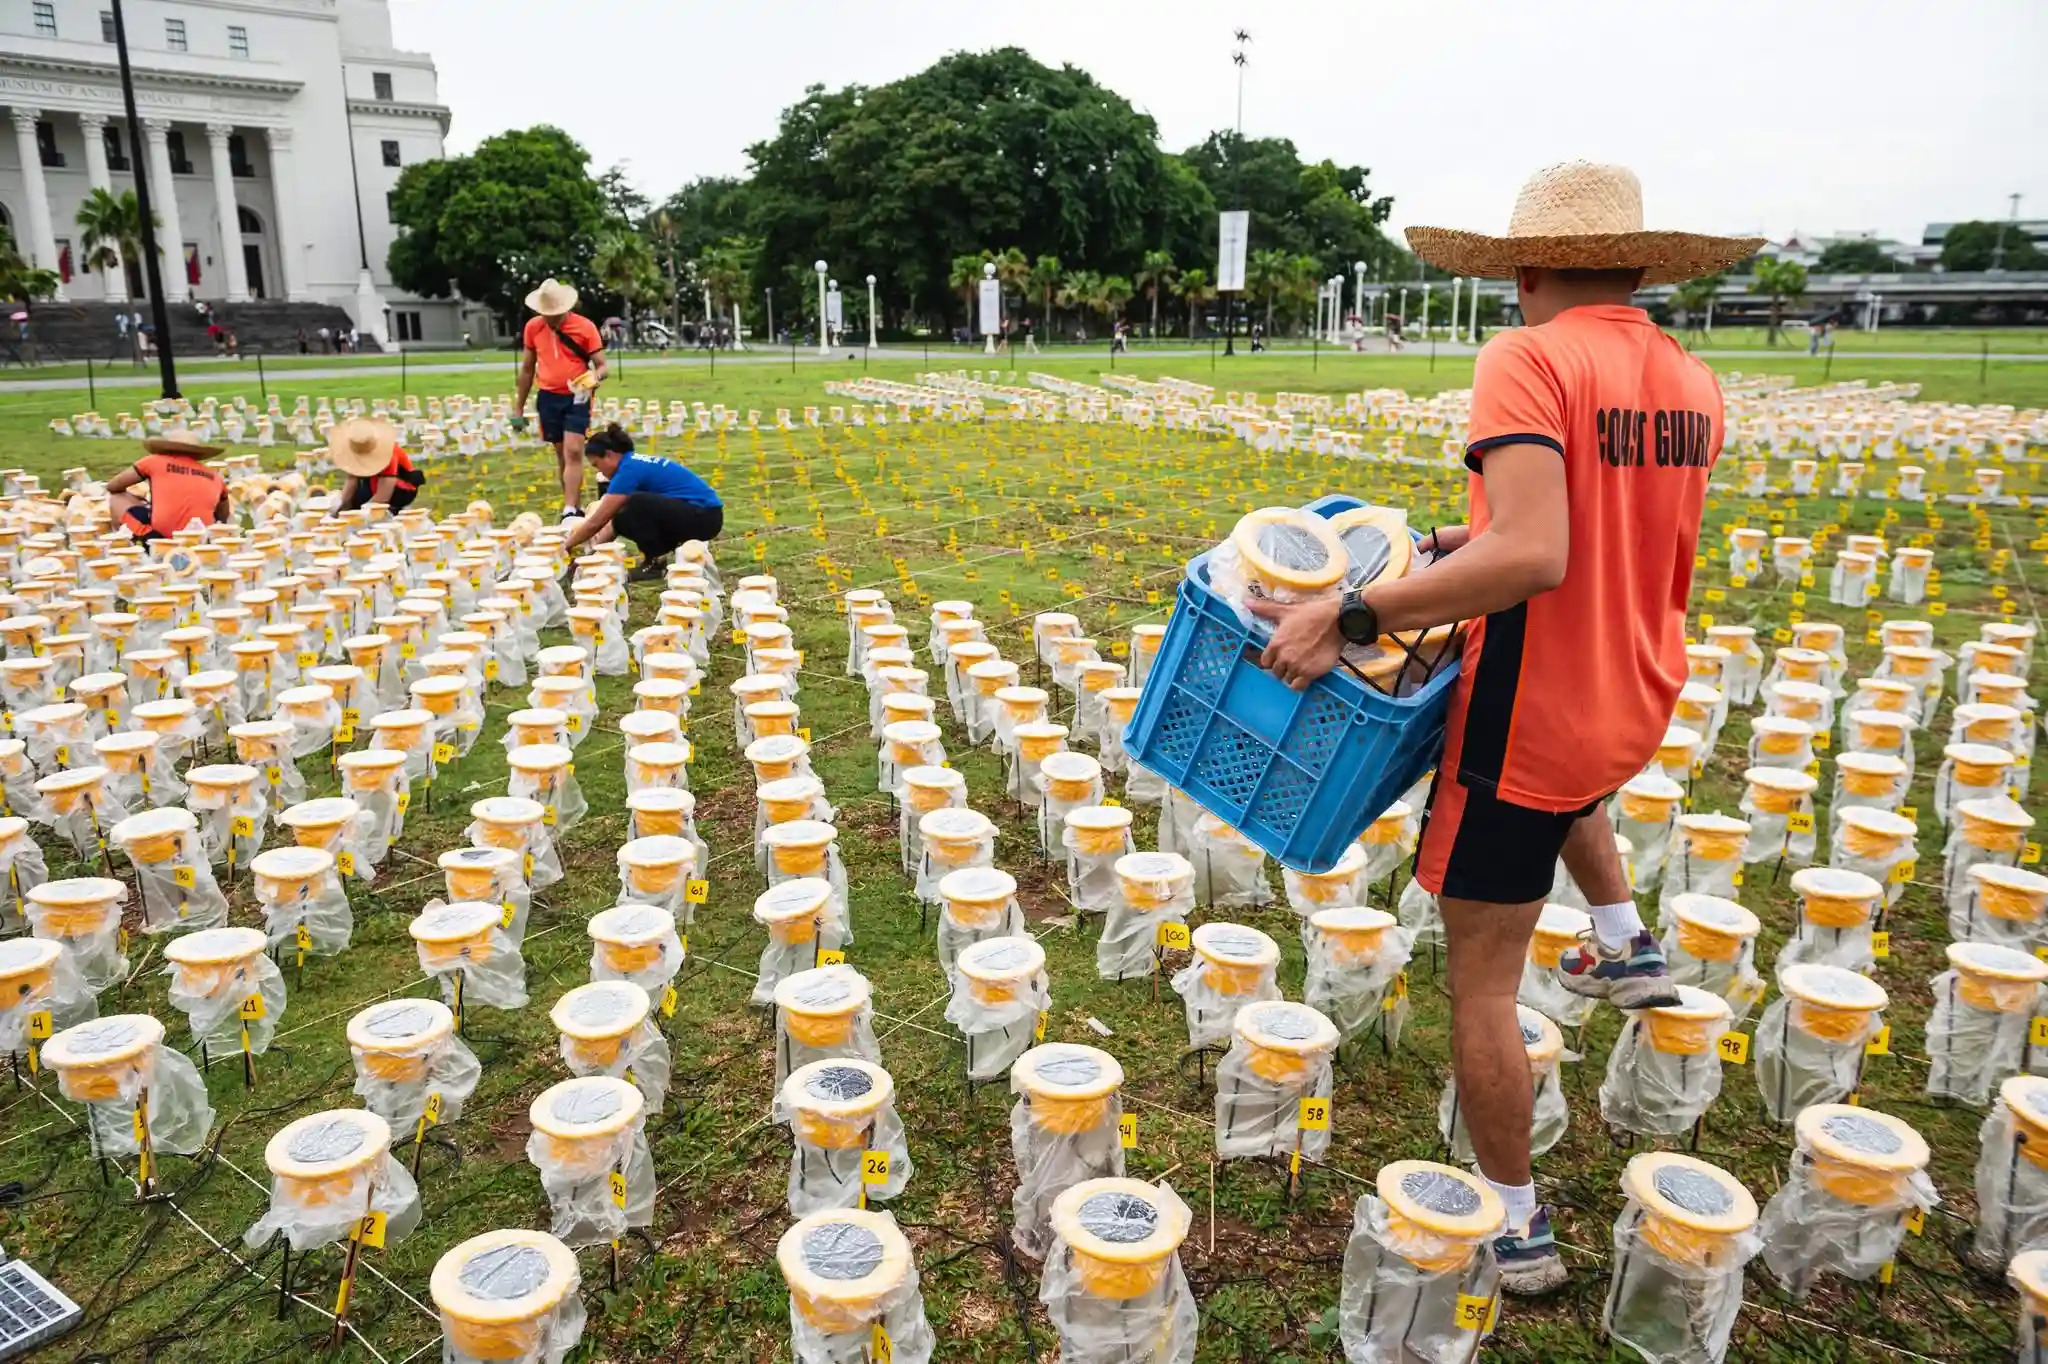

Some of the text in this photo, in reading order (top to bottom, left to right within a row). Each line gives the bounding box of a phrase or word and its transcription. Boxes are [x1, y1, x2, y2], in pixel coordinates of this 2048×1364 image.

[690, 885, 703, 896] 61
[1165, 928, 1185, 943] 100
[242, 999, 257, 1012] 21
[33, 1015, 43, 1031] 4
[1721, 1038, 1741, 1055] 98
[1307, 1107, 1324, 1121] 58
[867, 1159, 887, 1174] 26
[613, 1181, 624, 1197] 23
